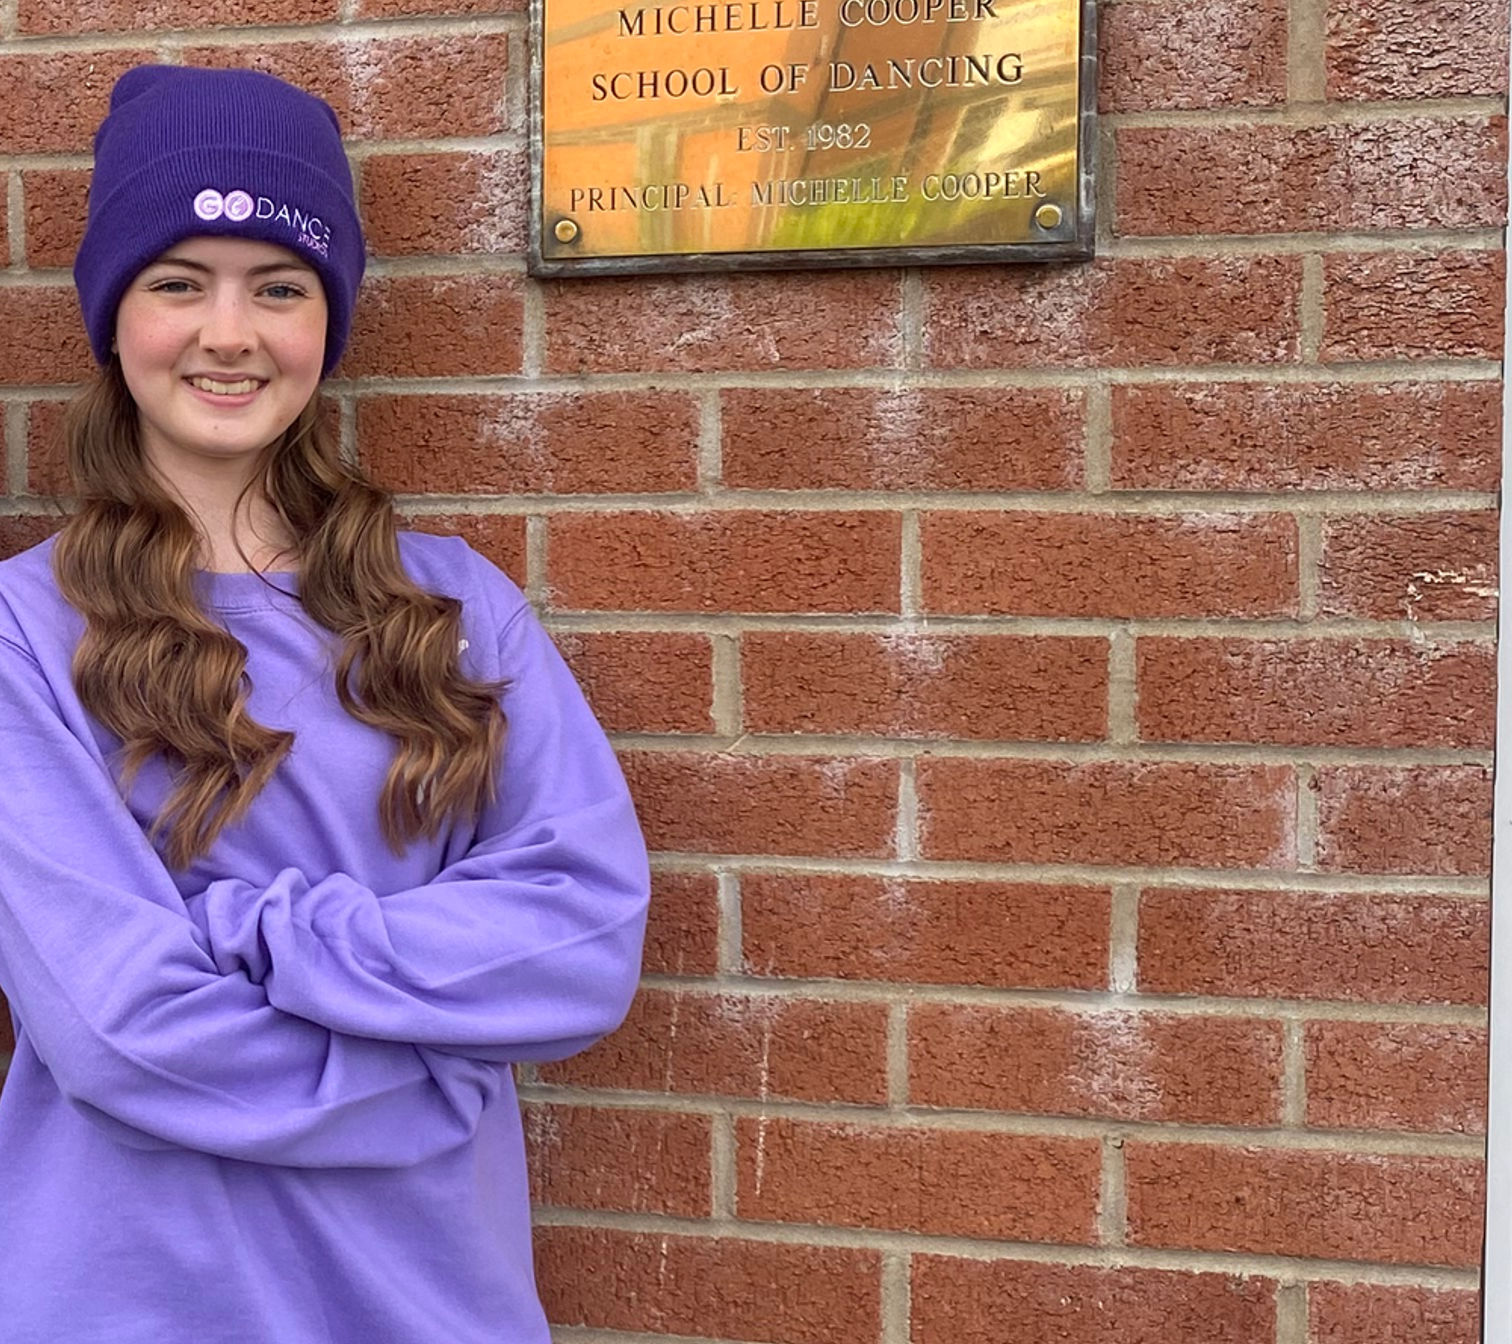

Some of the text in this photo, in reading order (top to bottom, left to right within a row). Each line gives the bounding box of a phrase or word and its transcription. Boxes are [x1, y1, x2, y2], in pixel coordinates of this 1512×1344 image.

[617, 0, 819, 38] MICHELLE
[591, 53, 1024, 102] SCHOOL OF DANCING
[736, 122, 871, 152] EST. 1982
[751, 175, 909, 208] MICHELLE
[920, 169, 1047, 202] COOPER
